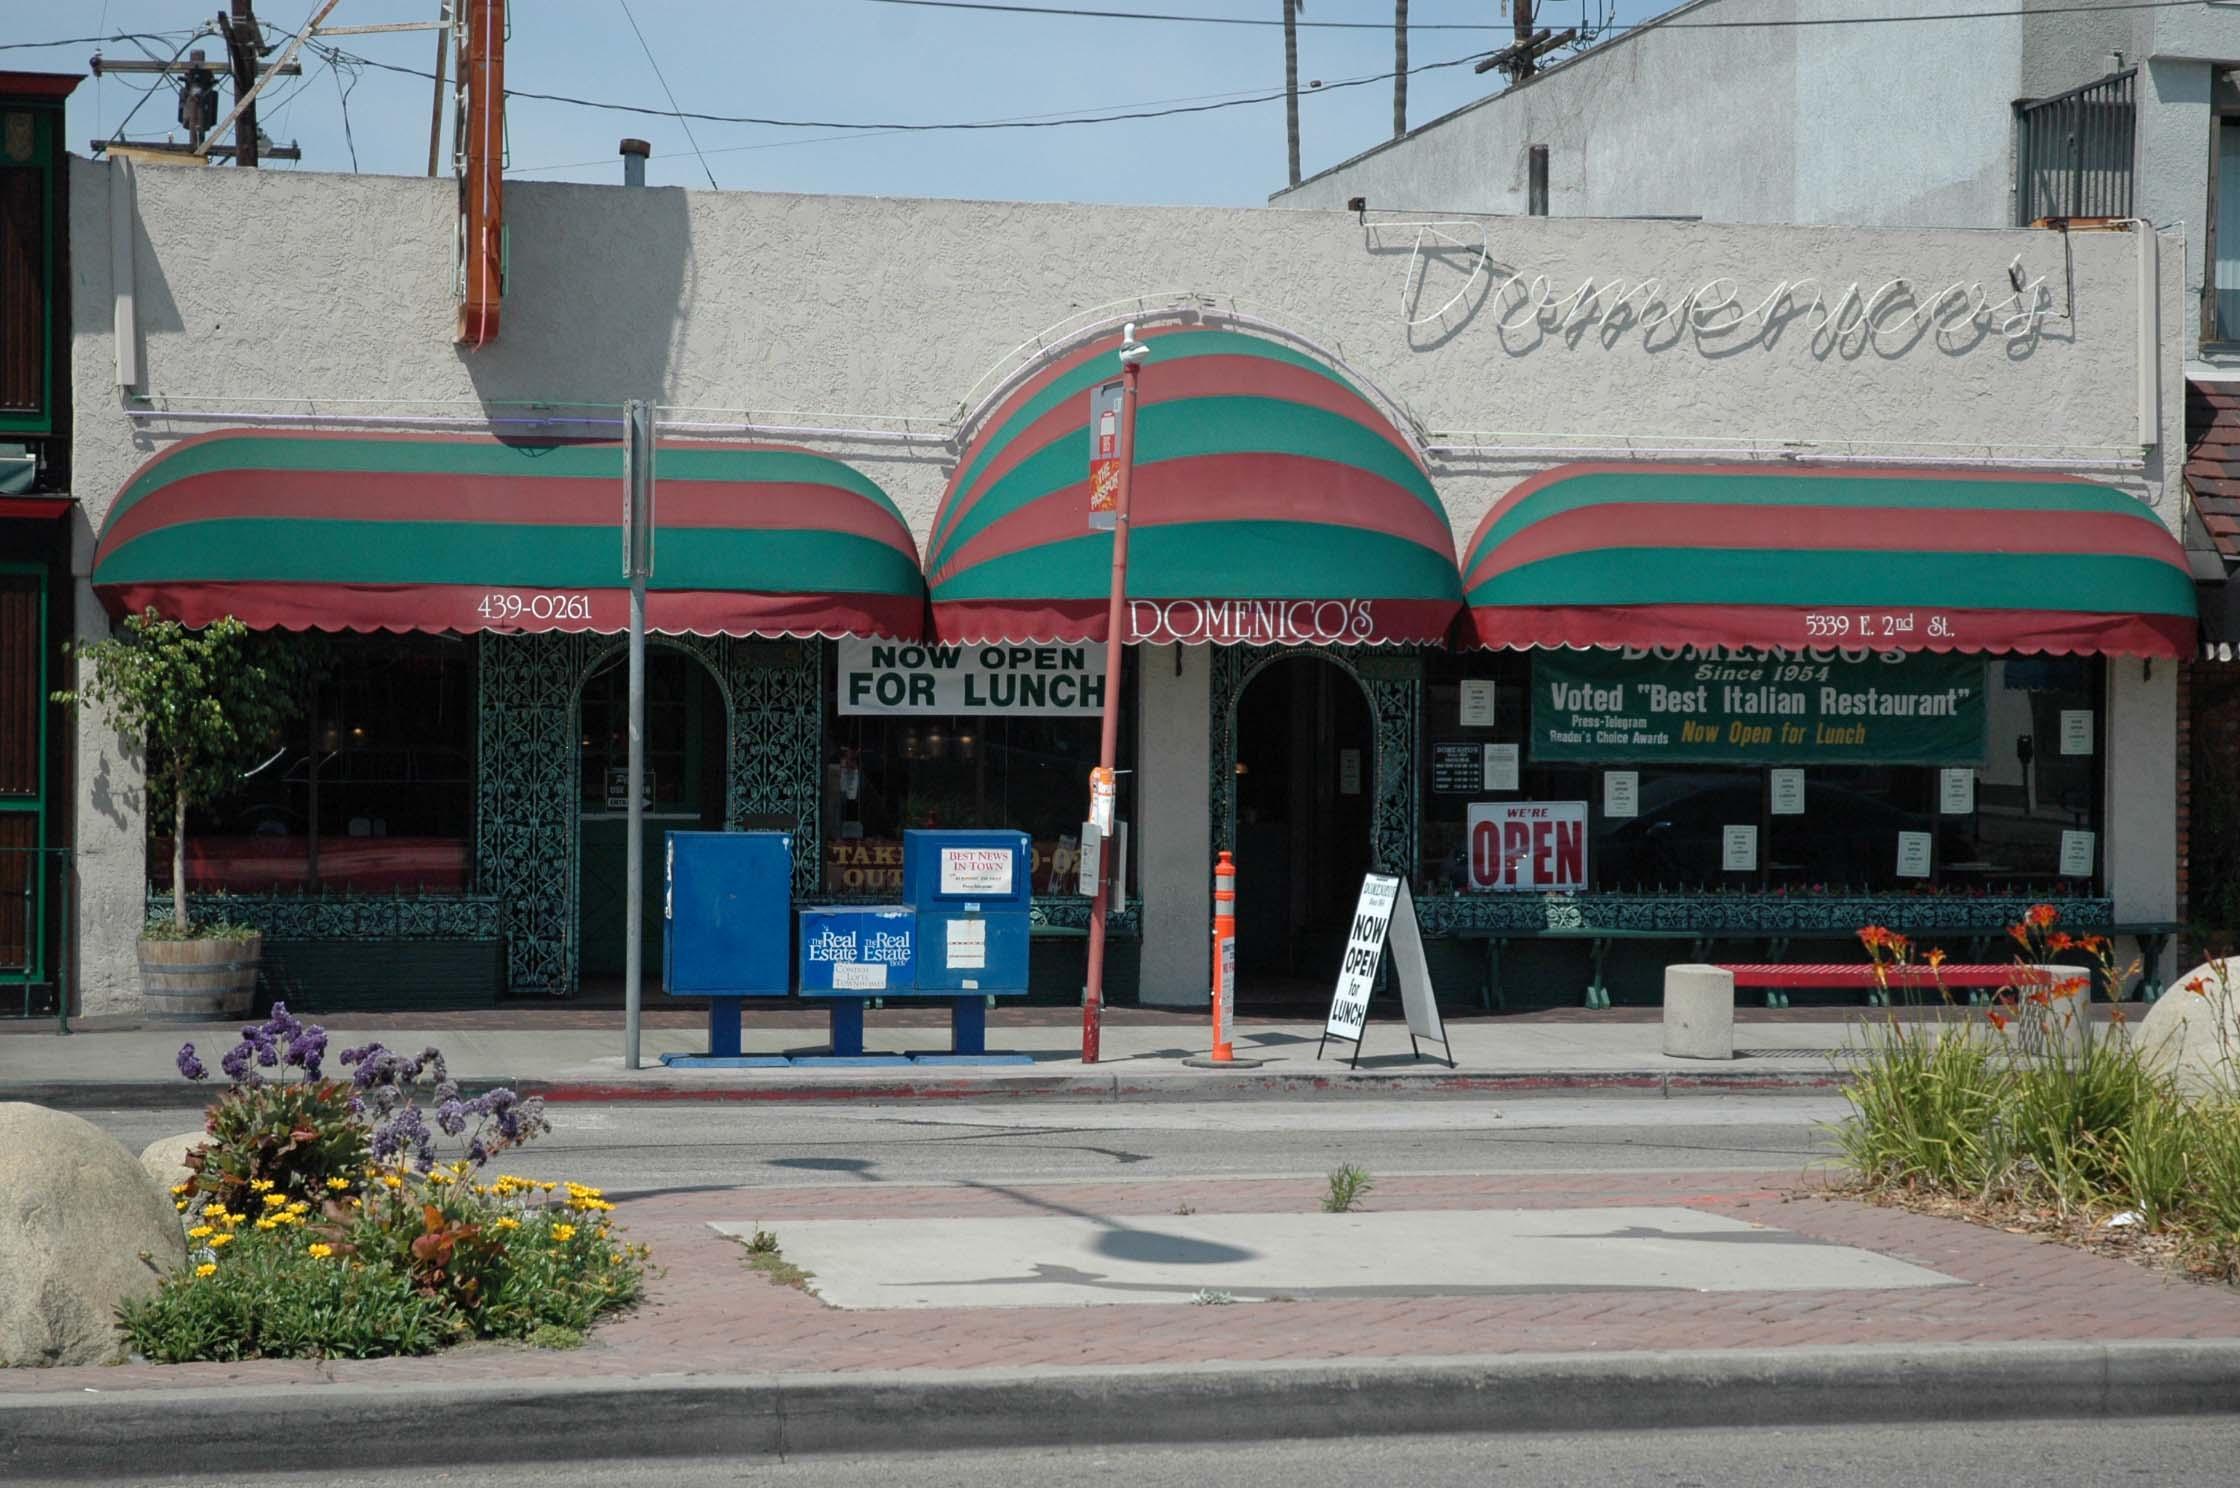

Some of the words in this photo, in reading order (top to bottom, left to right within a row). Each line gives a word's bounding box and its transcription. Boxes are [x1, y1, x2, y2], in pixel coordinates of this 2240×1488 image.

[477, 594, 592, 619] 439-0261
[1129, 598, 1374, 639] DOMENICO'S
[1806, 615, 1849, 636] 5339
[1859, 615, 1875, 636] E.
[1882, 613, 1914, 636] 2nd
[1927, 616, 1955, 637] St.
[872, 645, 961, 669] NOW
[979, 647, 1085, 670] OPEN
[1695, 664, 1764, 681] Since
[1774, 666, 1829, 682] 1954
[849, 672, 936, 706] FOR
[964, 673, 1106, 708] LUNCH
[1551, 682, 1624, 712] Voted
[1637, 684, 1708, 713] "Best
[1723, 686, 1806, 715] Italian
[1572, 715, 1648, 730] Press-Telegram
[1550, 730, 1592, 744] Reader's
[1596, 731, 1628, 745] Choice
[1632, 732, 1669, 745] Awards
[1681, 720, 1720, 743] Now
[1729, 720, 1773, 748] Open
[1781, 721, 1808, 745] for
[1816, 722, 1867, 745] Lunch
[1507, 808, 1549, 818] WE'RE
[949, 851, 975, 861] BEST
[979, 851, 1008, 861] NEWS
[1473, 820, 1583, 886] OPEN
[954, 862, 967, 871] IN
[970, 861, 1003, 871] TOWN
[1352, 913, 1387, 944] NOW
[822, 931, 857, 948] Real
[876, 931, 910, 948] Real
[809, 945, 858, 961] Estate
[864, 945, 912, 961] Estate
[1345, 947, 1378, 978] OPEN
[1348, 978, 1360, 997] for
[1332, 999, 1365, 1027] LUNCH
